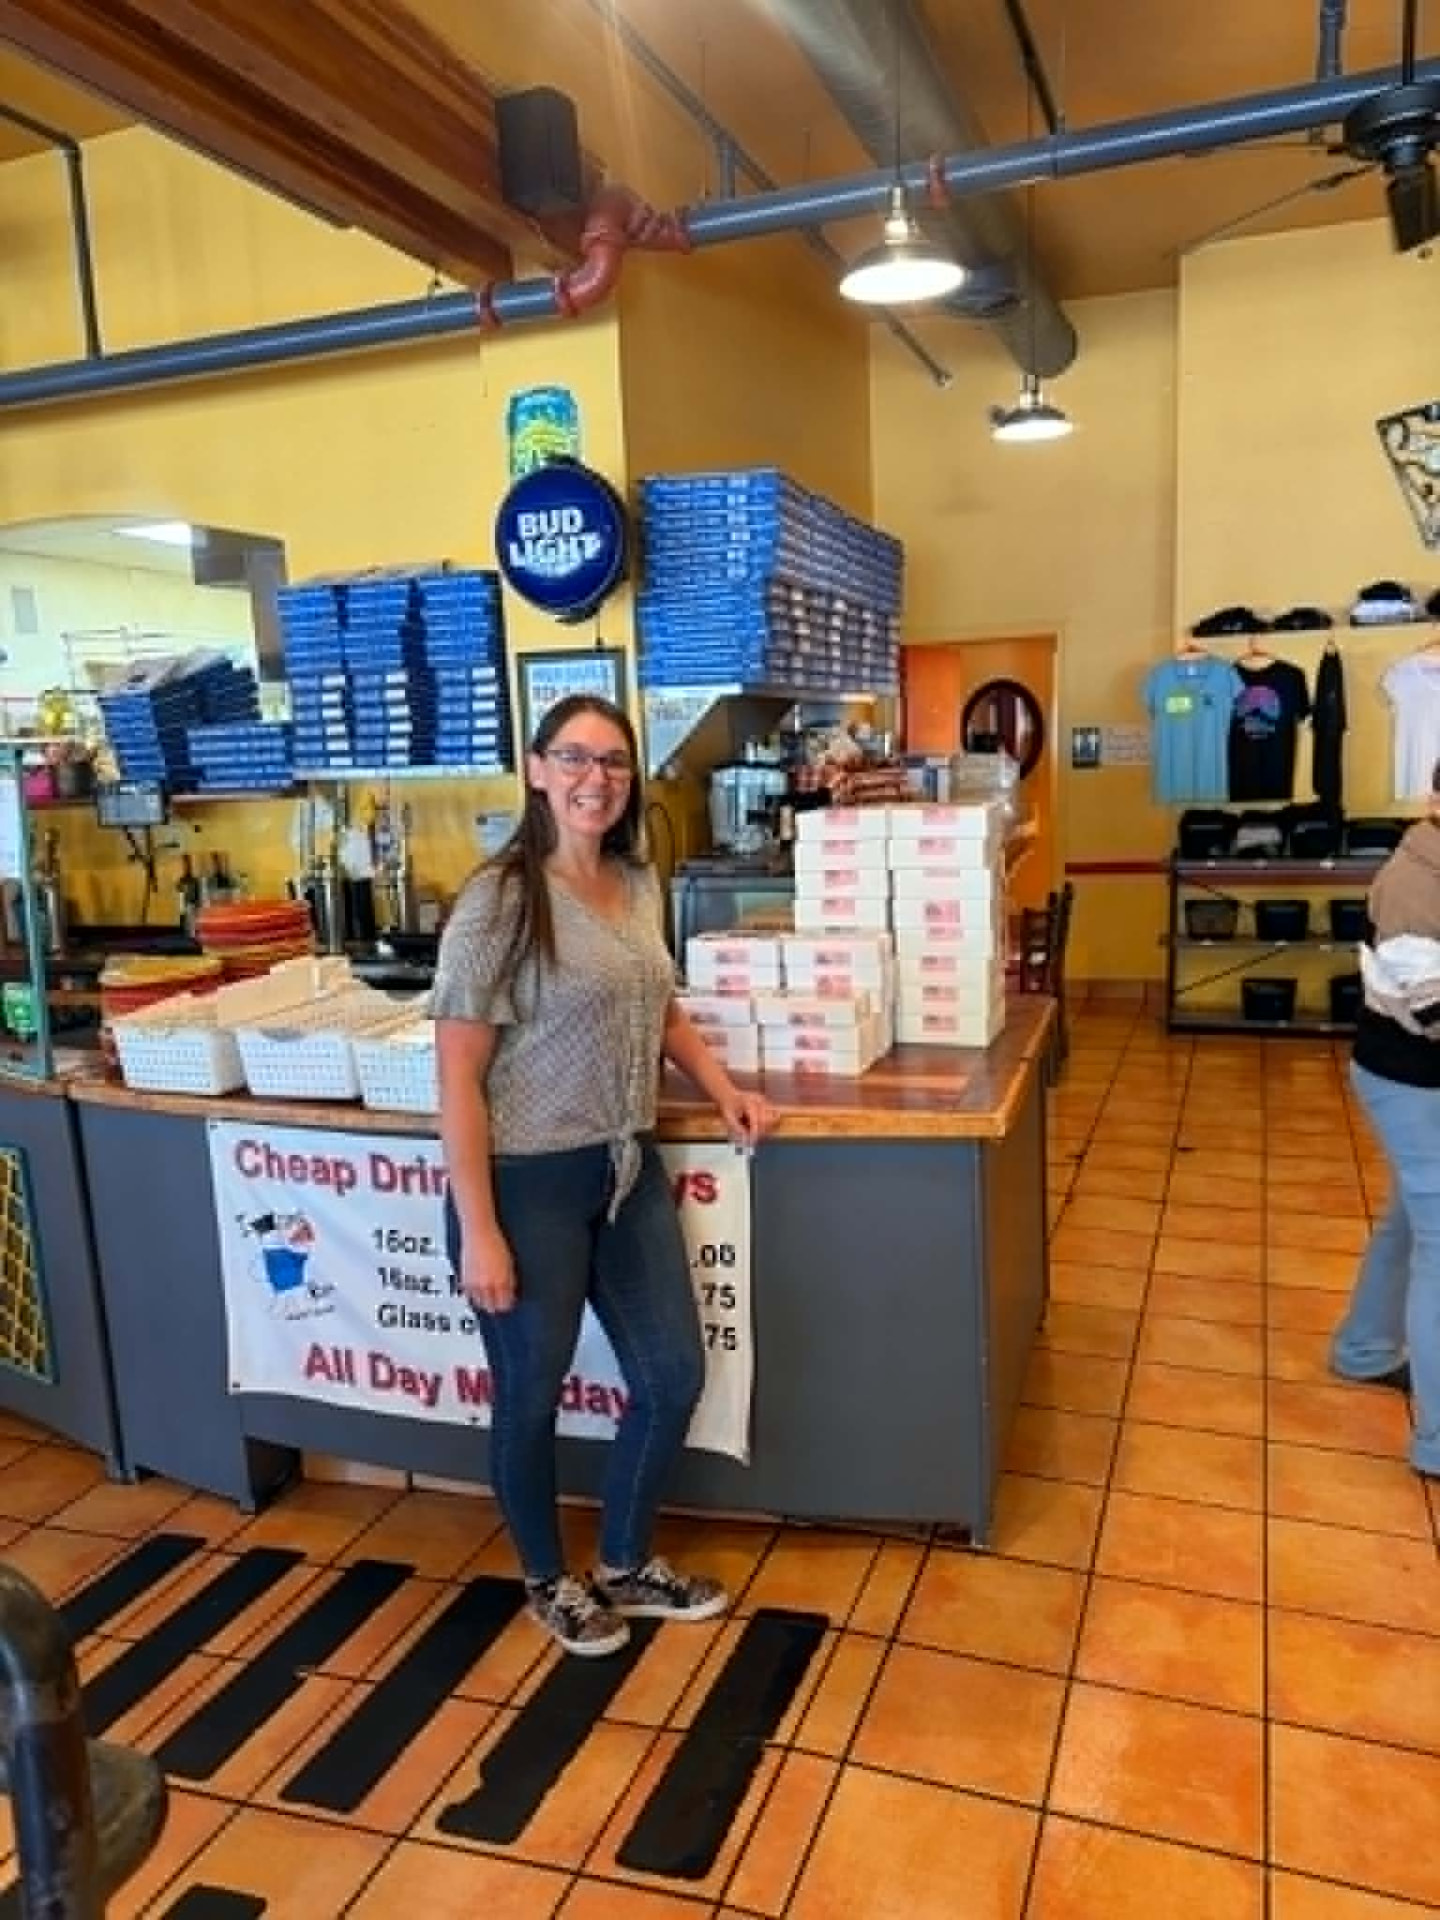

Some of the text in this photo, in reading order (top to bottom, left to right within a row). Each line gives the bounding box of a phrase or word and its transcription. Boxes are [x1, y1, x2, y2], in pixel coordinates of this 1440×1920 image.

[516, 508, 583, 540] BUD
[509, 532, 601, 568] LIGHT
[235, 1138, 357, 1197] Cheap
[369, 1153, 450, 1195] Drin
[378, 1304, 450, 1333] Glass
[305, 1342, 356, 1384] All
[367, 1351, 443, 1407] Day
